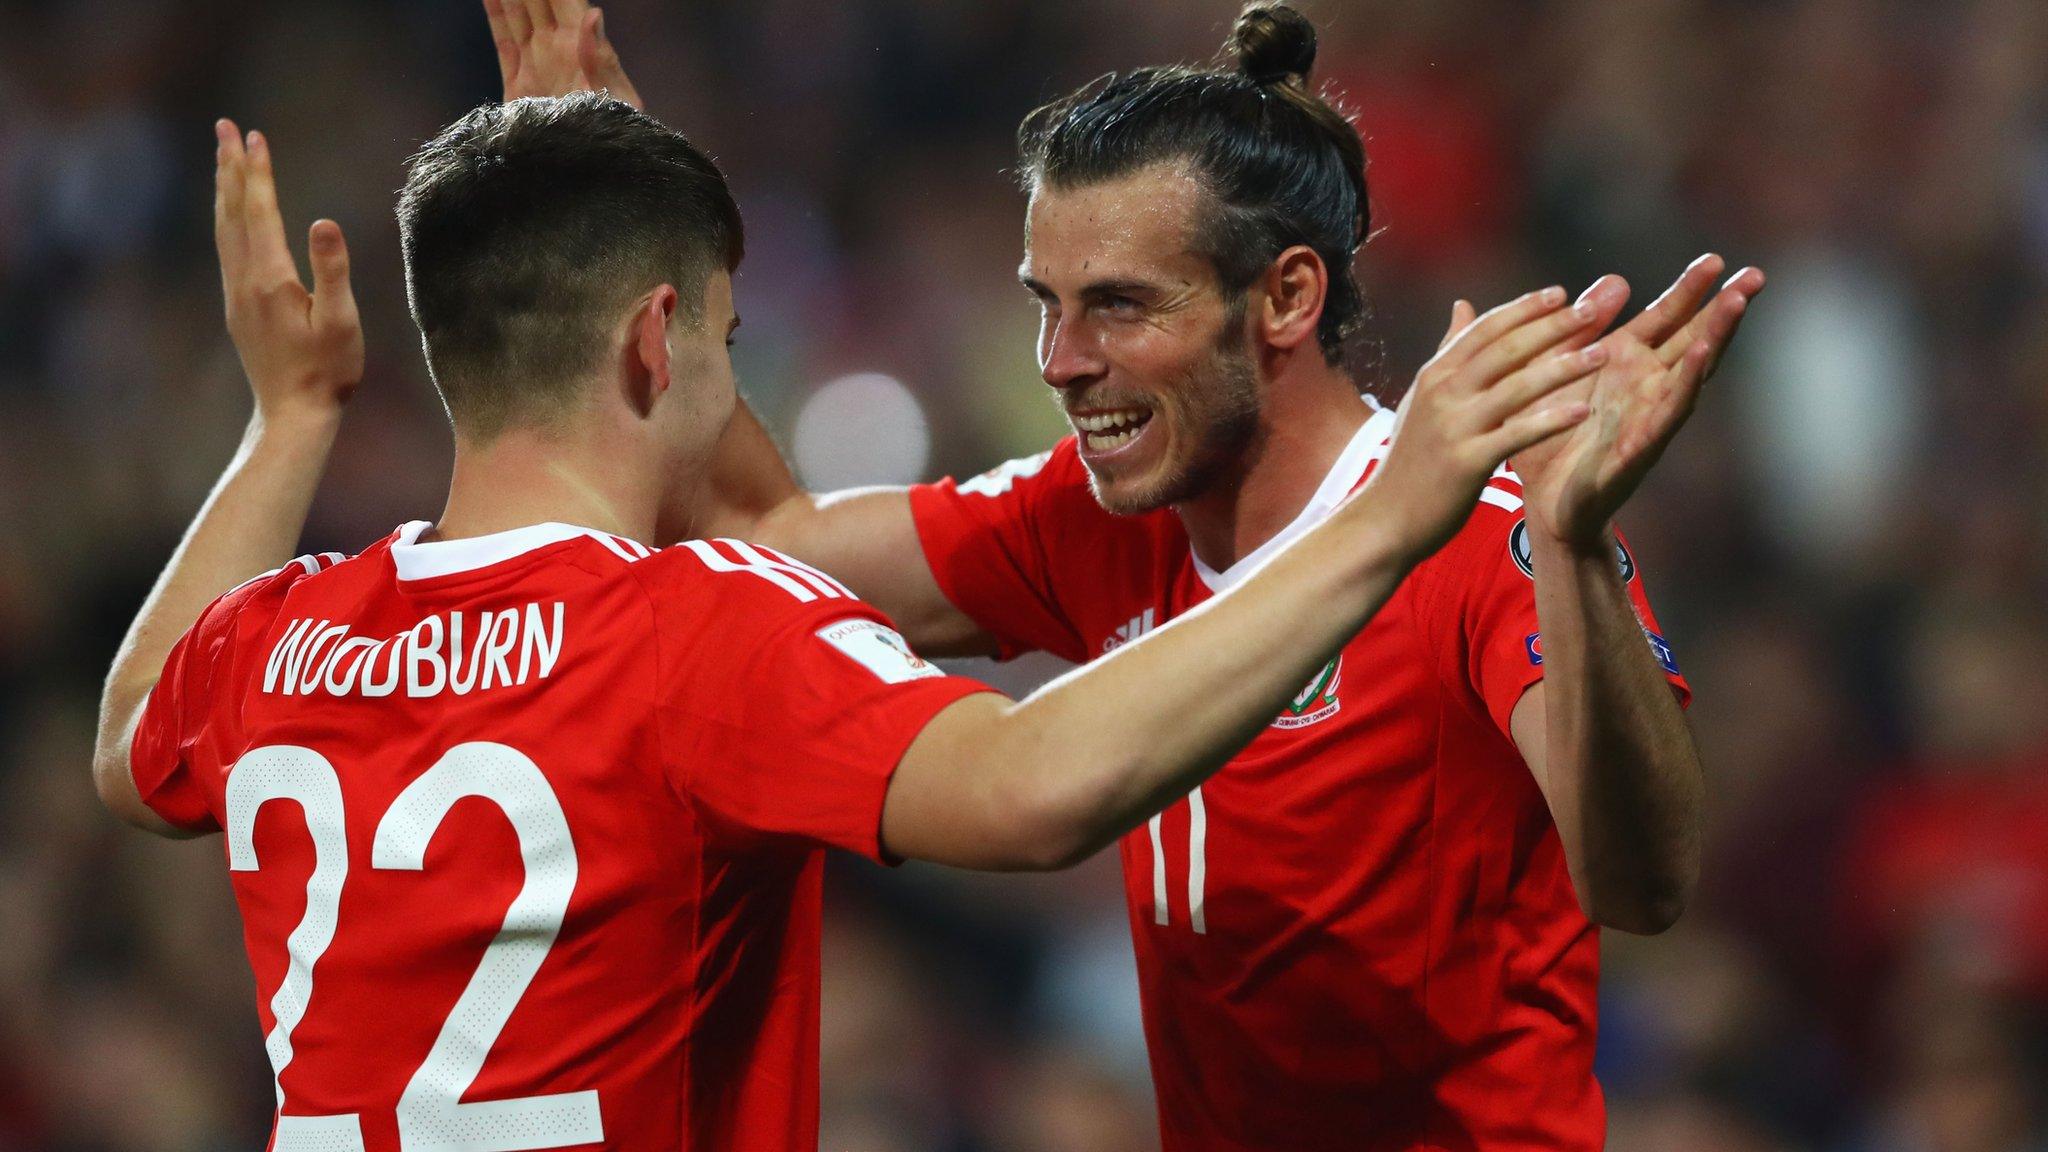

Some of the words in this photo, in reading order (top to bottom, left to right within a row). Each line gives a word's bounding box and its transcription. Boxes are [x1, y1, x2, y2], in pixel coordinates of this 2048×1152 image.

[262, 601, 565, 698] WOODBURN
[1148, 785, 1207, 935] 11
[225, 741, 604, 1152] 22
